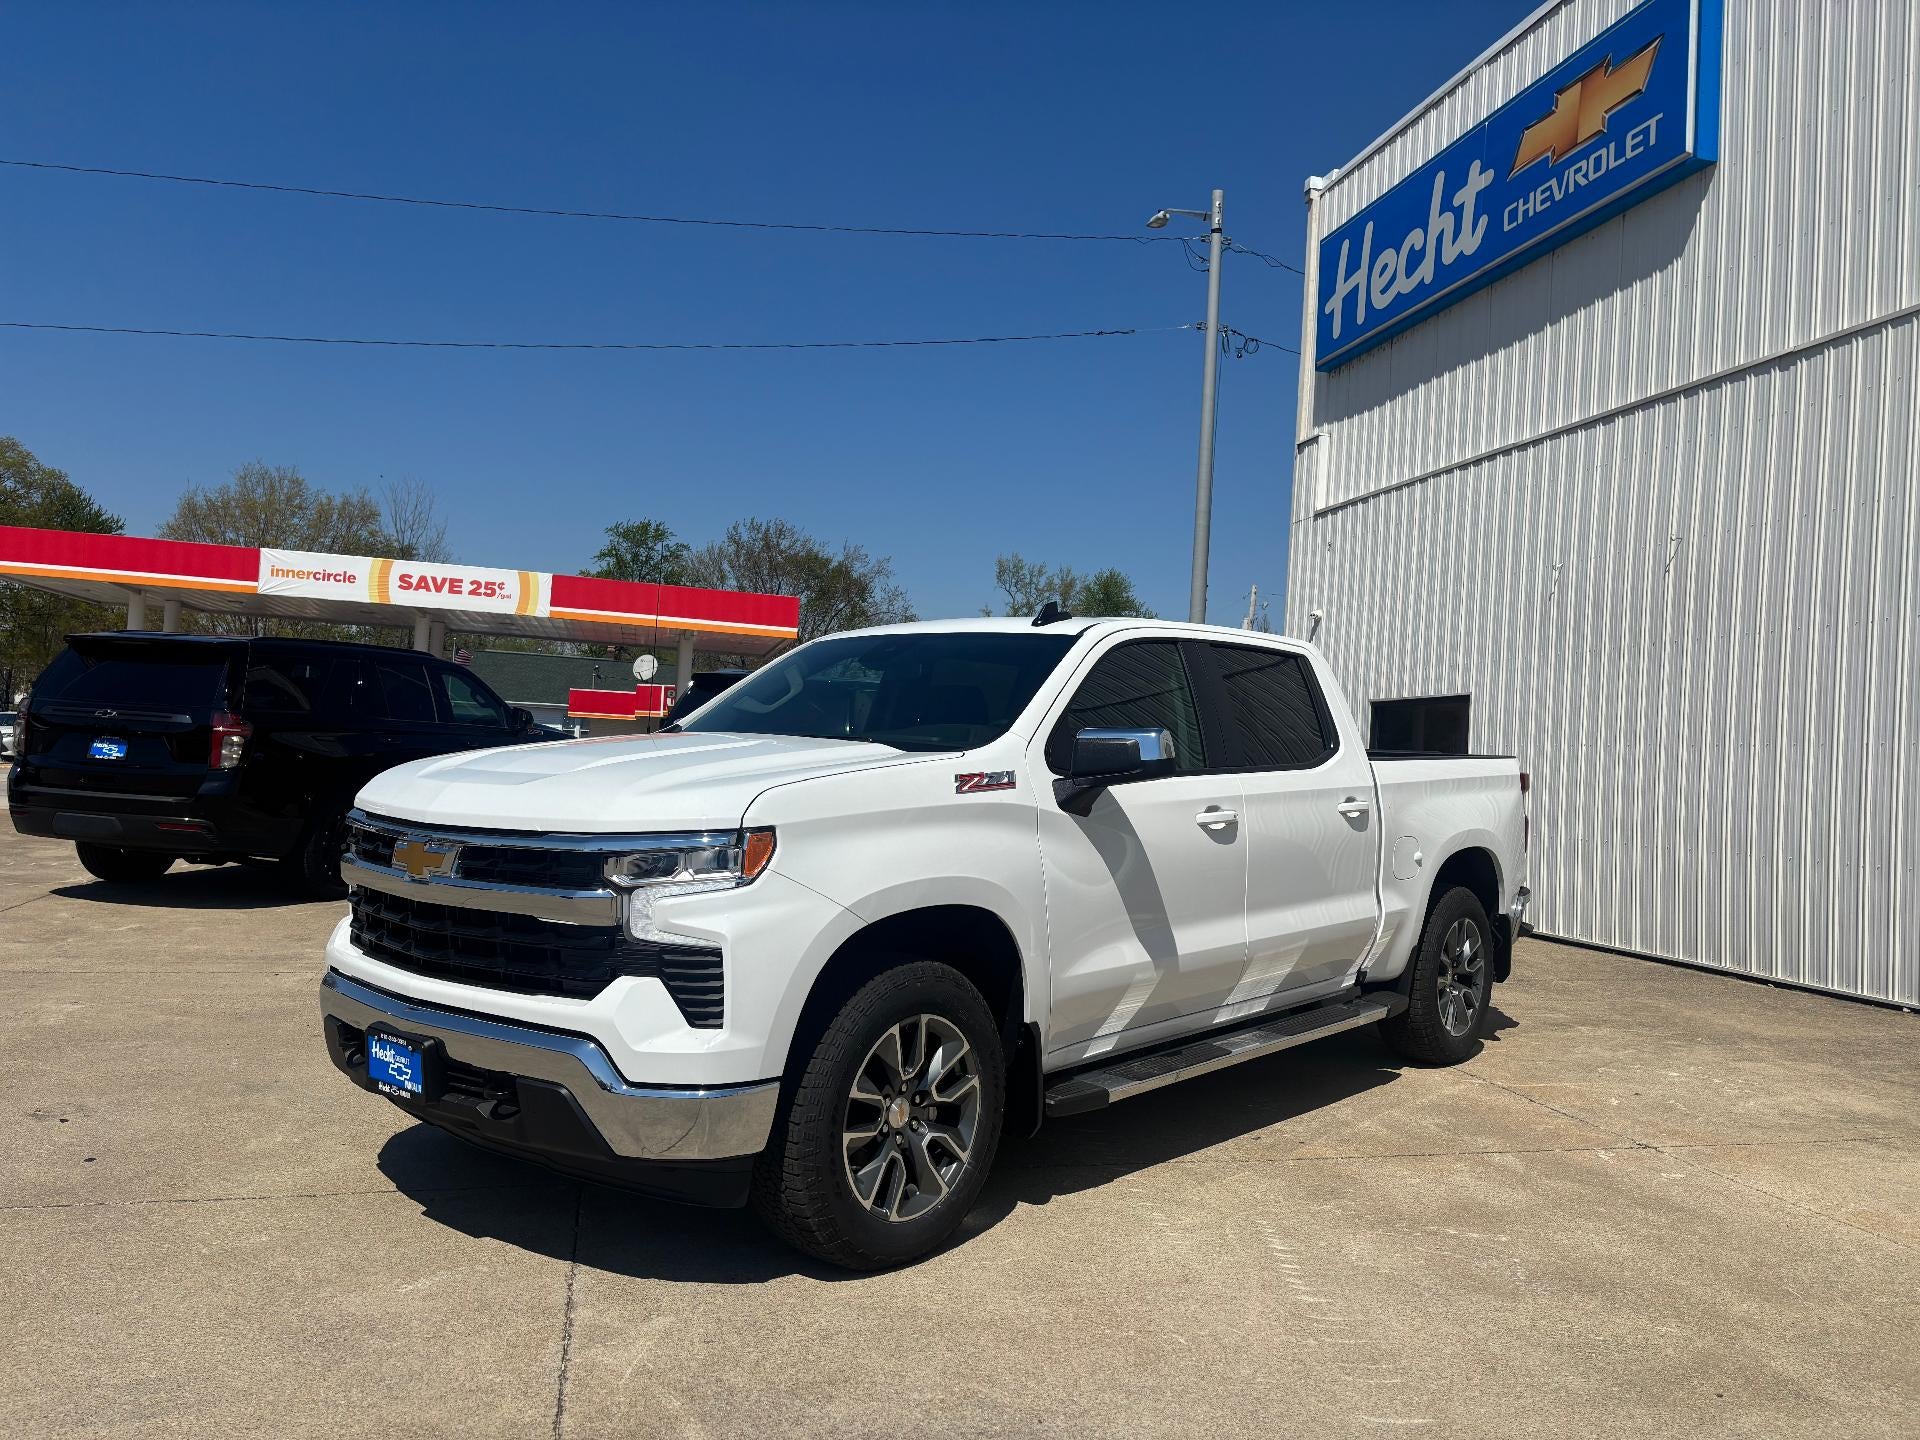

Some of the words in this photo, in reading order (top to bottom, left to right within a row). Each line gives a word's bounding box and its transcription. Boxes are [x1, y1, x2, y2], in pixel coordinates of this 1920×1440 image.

[1325, 160, 1495, 339] Hecht
[1503, 112, 1664, 232] CHEVROLET
[270, 564, 357, 584] innercircle
[398, 573, 464, 595] SAVE
[954, 770, 1016, 794] Z71
[371, 1040, 395, 1064] Hecht
